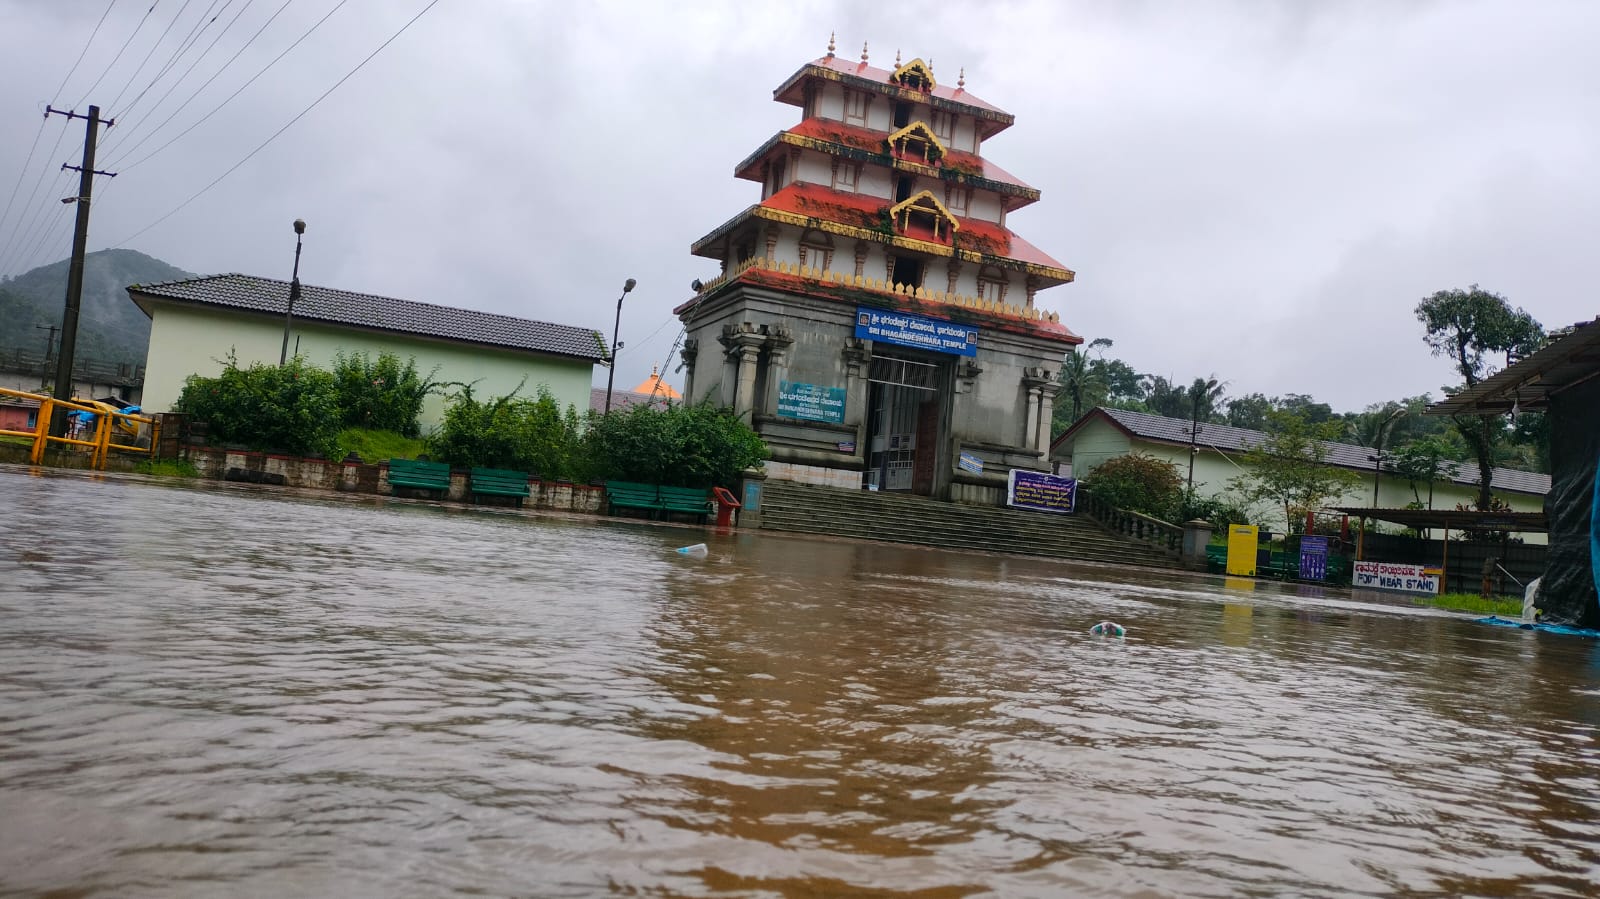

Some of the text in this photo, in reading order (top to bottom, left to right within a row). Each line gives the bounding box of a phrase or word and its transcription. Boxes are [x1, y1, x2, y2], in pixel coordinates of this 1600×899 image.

[868, 327, 880, 335] SRI
[880, 329, 941, 346] BHAGANDESHWARA
[942, 340, 967, 350] TEMPLE
[1357, 573, 1435, 592] FOOT WEAR STAND
